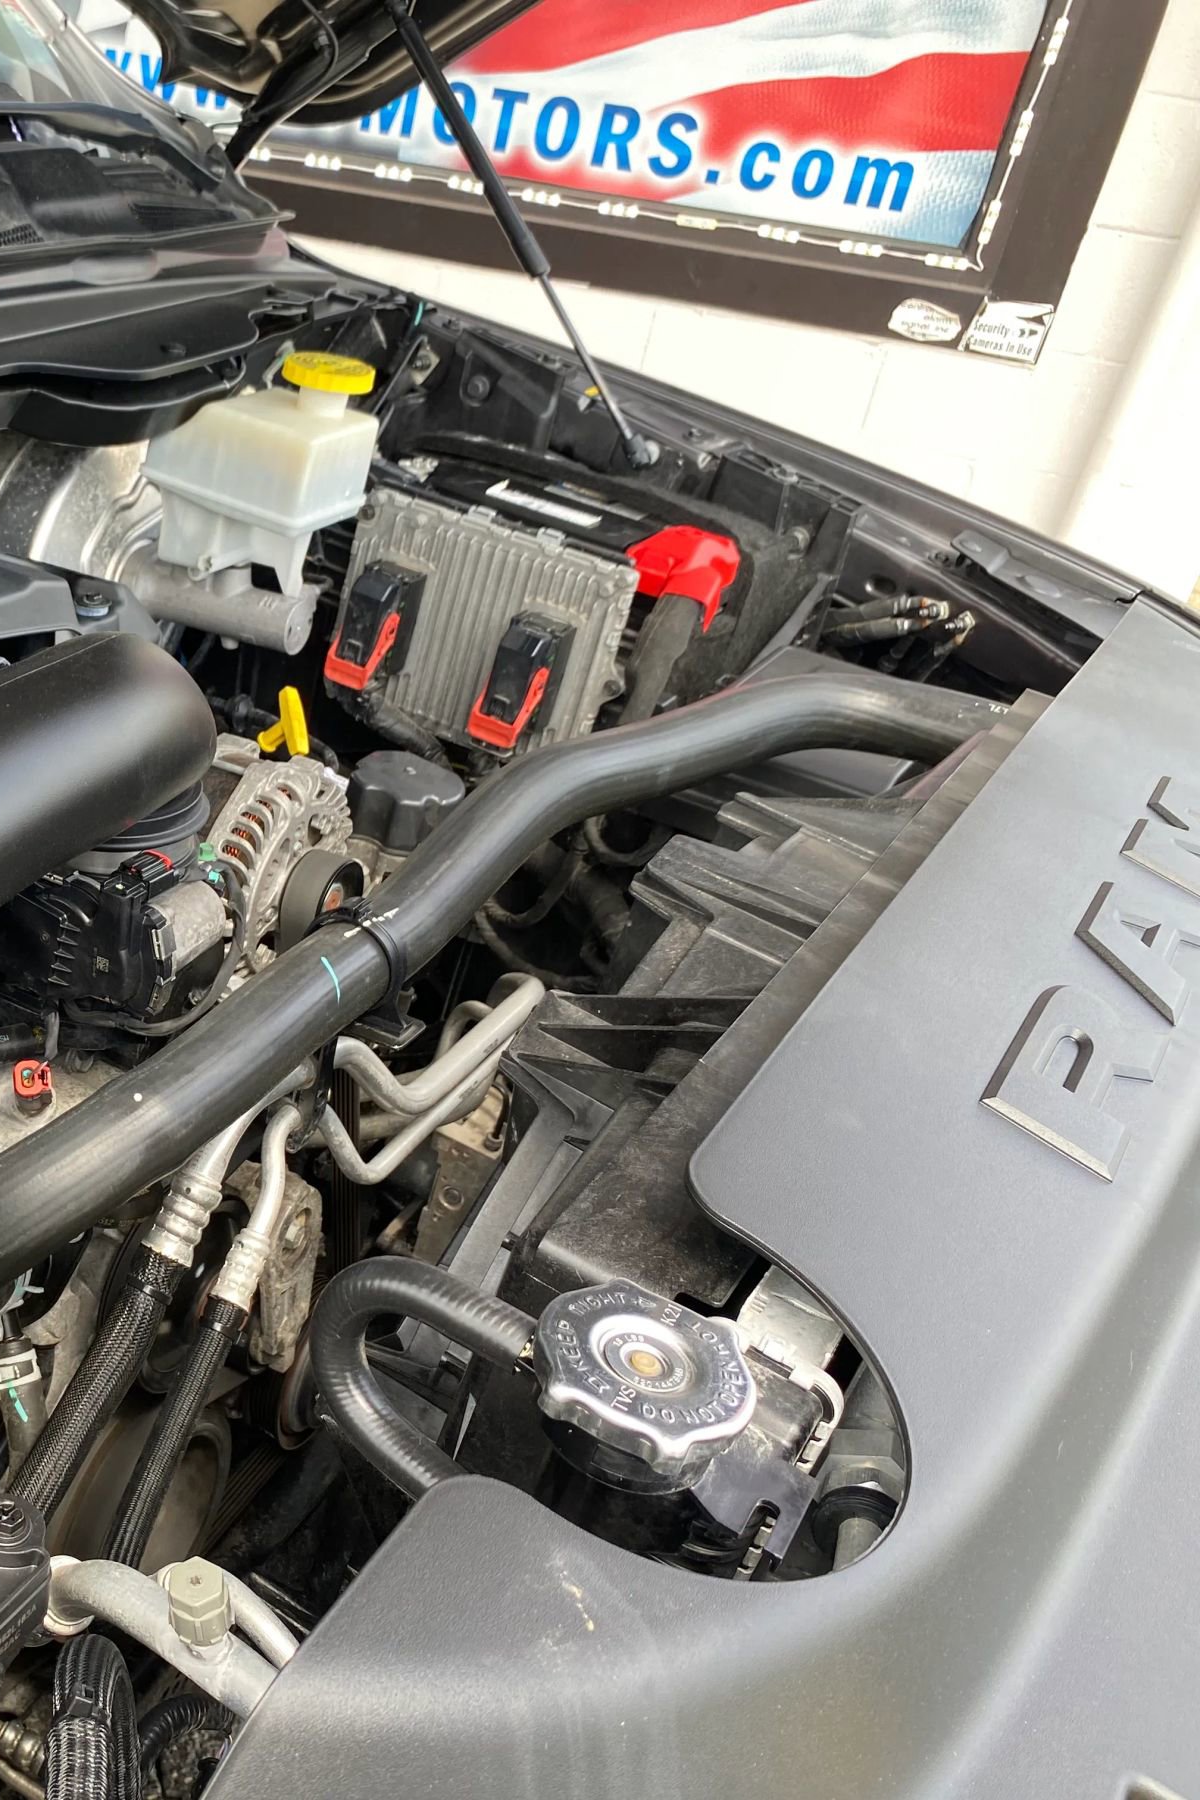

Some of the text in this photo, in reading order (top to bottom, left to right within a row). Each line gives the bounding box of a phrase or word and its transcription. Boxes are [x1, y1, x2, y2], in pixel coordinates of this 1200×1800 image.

[972, 318, 1011, 336] Security
[1005, 339, 1015, 352] In
[1016, 342, 1033, 356] Use
[660, 1302, 683, 1328] K21
[557, 1319, 589, 1372] KEEP
[610, 1384, 637, 1412] TVS
[641, 1401, 676, 1425] DO
[679, 1399, 727, 1425] NOT
